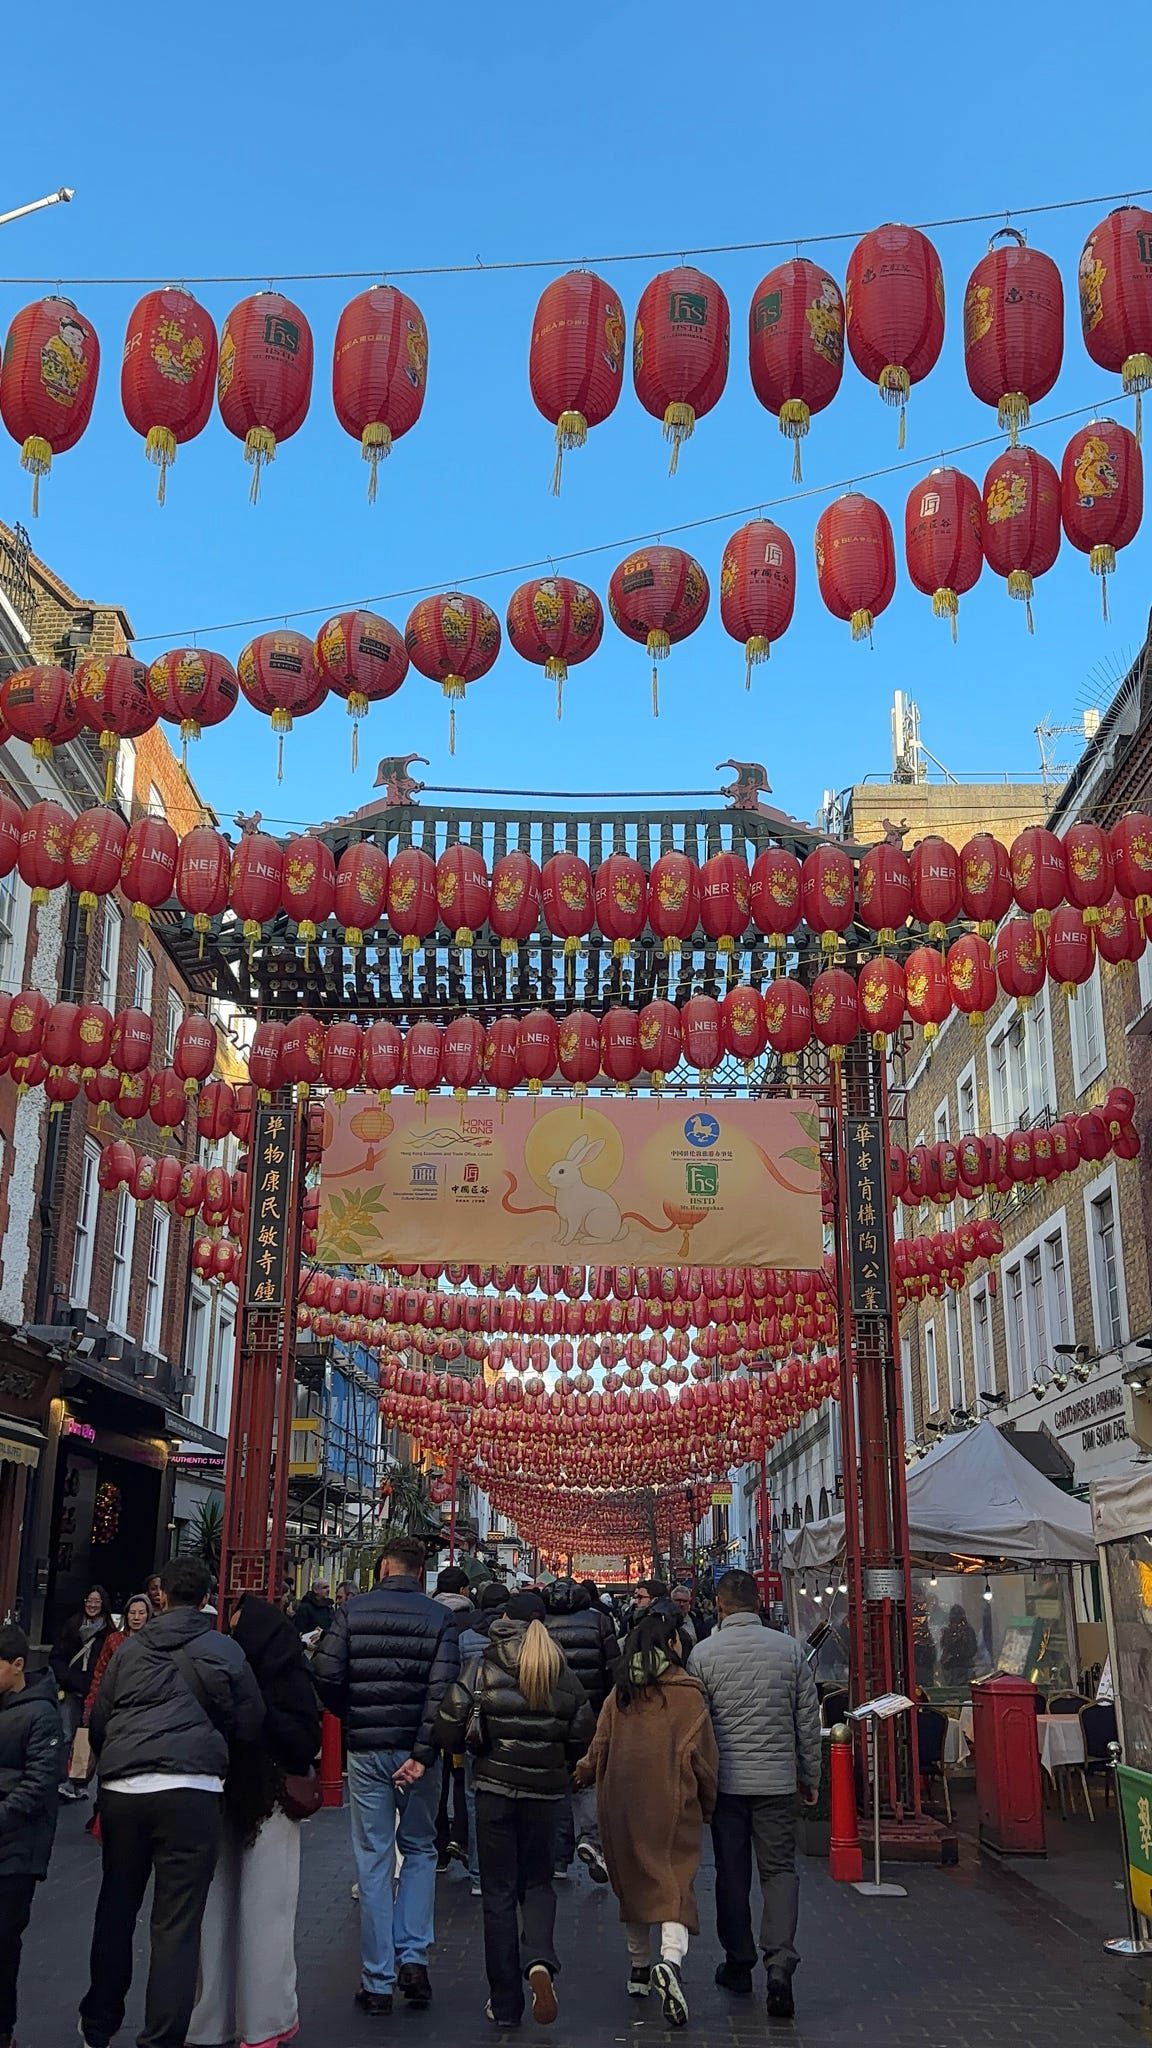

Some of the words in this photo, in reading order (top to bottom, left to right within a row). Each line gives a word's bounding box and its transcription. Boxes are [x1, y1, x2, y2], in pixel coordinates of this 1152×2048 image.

[142, 848, 175, 870] LNER
[182, 859, 219, 871] LNER
[248, 862, 281, 882] LNER
[922, 865, 956, 878] LNER
[1054, 931, 1088, 943] LNER
[689, 1021, 718, 1032] LNER
[183, 1036, 211, 1047] LNER
[521, 1033, 550, 1044] LNER
[252, 1045, 278, 1058] LNER
[328, 1044, 356, 1056] LNER
[372, 1044, 399, 1055] LNER
[412, 1044, 440, 1056] LNER
[445, 1042, 472, 1053] LNER
[462, 1119, 493, 1127] HONG
[462, 1127, 493, 1135] KONG
[689, 1197, 716, 1205] HSTD
[1082, 1430, 1096, 1452] DIM
[1096, 1423, 1113, 1448] SUM
